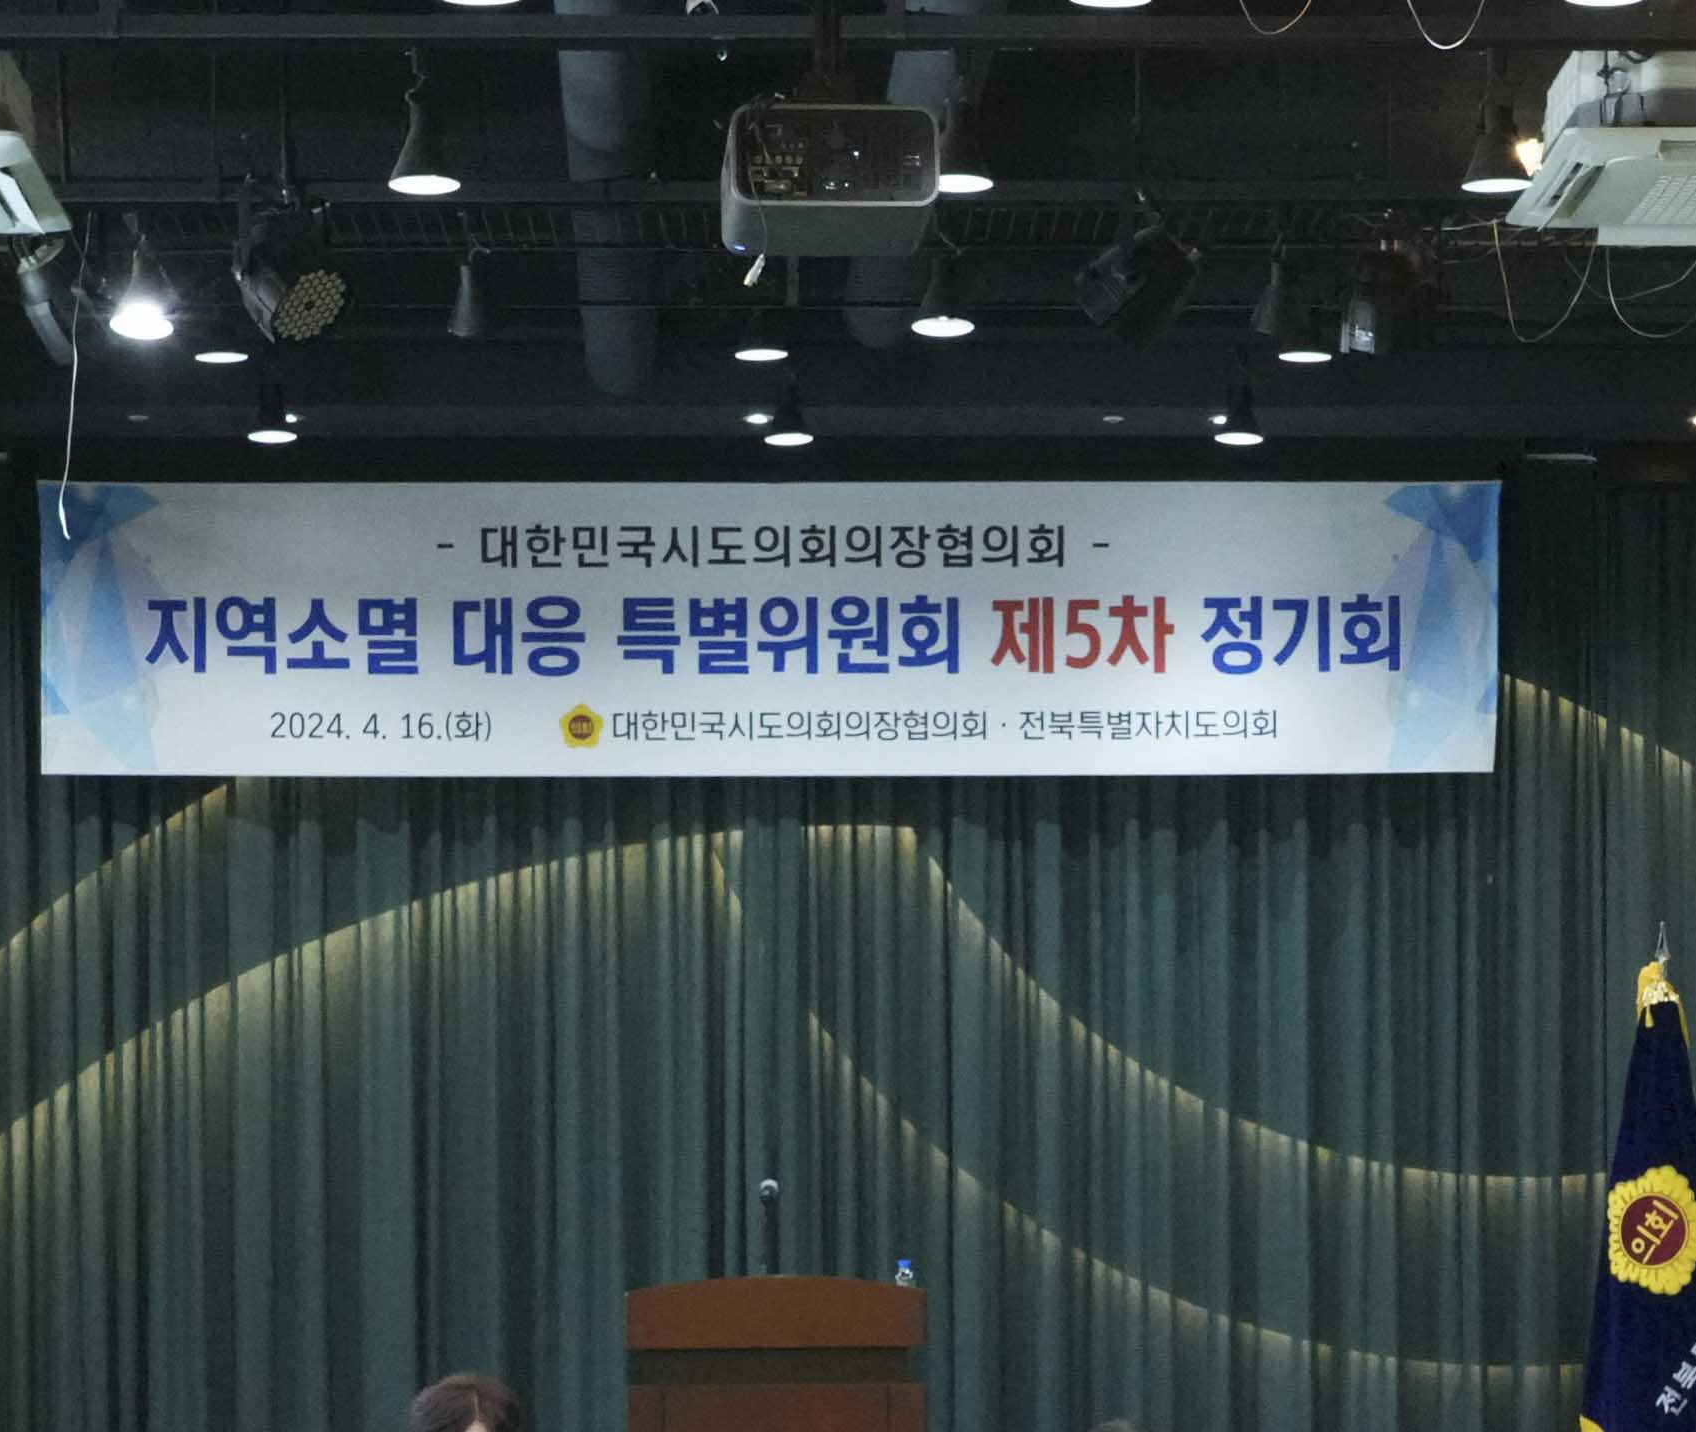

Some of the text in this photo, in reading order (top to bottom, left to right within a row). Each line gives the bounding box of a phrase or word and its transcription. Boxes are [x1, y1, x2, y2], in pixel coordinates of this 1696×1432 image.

[481, 523, 1065, 569] 대한민국시도의회의장협의회
[146, 594, 1404, 677] 지역소멸 대응 특별위원회 제5차 정기회
[270, 710, 492, 742] 2024. 4. 16.(화)
[612, 709, 987, 742] 대한민국시도의회의장협의회
[1019, 708, 1277, 742] 전북특별자치도의회
[1630, 1199, 1679, 1265] 의회
